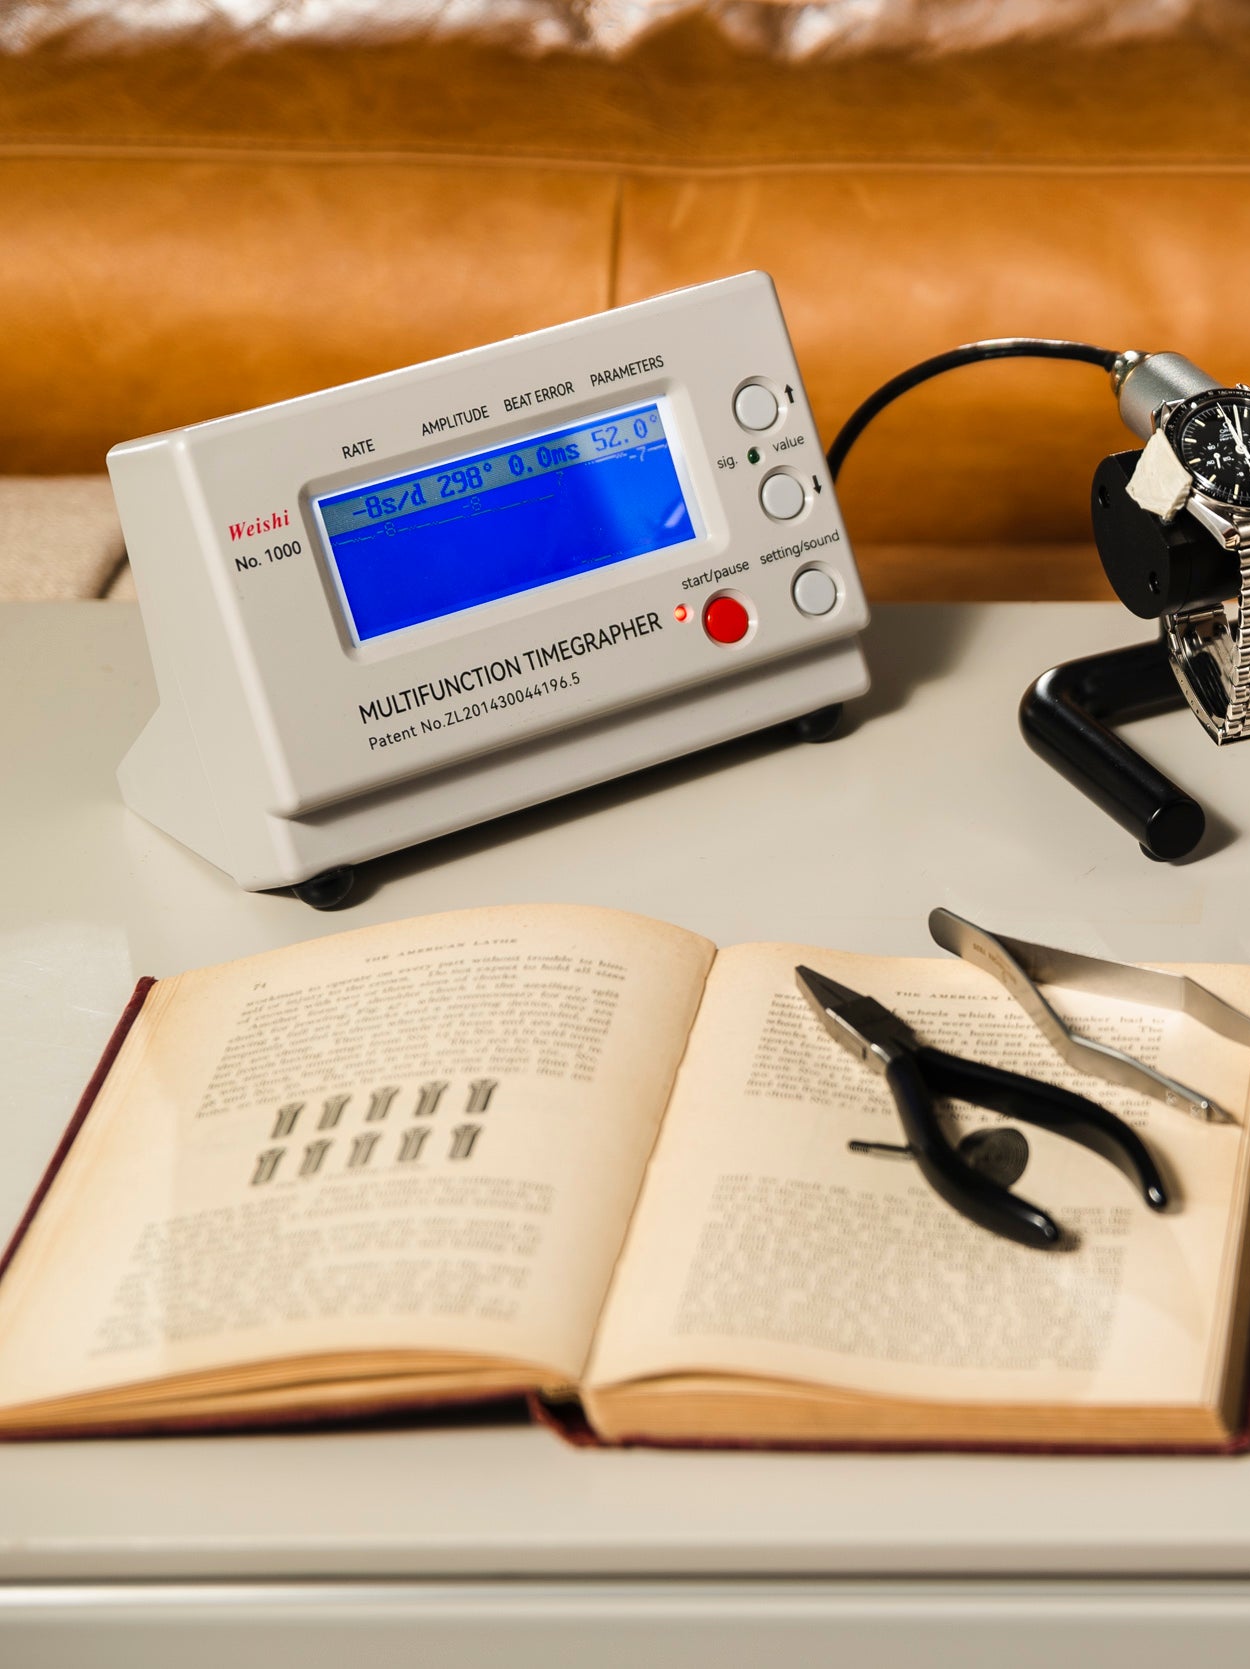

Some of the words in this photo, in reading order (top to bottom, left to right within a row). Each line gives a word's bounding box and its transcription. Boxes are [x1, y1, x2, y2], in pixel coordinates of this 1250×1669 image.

[590, 355, 664, 387] PARAMETERS
[503, 392, 532, 412] BEAT
[534, 381, 575, 406] ERROR
[422, 405, 490, 436] AMPLITUDE
[342, 438, 376, 459] RATE
[772, 434, 805, 453] value
[352, 482, 426, 519] -8s/d
[437, 462, 493, 498] 298°
[508, 442, 581, 477] 0.0ms
[592, 414, 658, 451] 52.0°
[717, 457, 738, 474] sig.
[228, 510, 291, 542] Weishi
[235, 554, 262, 572] No.
[264, 540, 302, 563] 1000
[760, 530, 840, 565] setting/sound
[681, 560, 750, 590] start/pause
[358, 656, 522, 724] MULTIFUNCTION
[522, 612, 662, 671] TIMEGRAPHER
[368, 725, 418, 750] Patent
[420, 672, 581, 734] No.ZL201430044196.5
[365, 955, 389, 963] THE
[398, 942, 465, 956] AMERICAN
[473, 938, 518, 946] LATHE
[896, 990, 921, 998] THE
[928, 993, 999, 1001] AMERICAN
[906, 1008, 949, 1018] wheels
[958, 1011, 996, 1020] which
[1004, 1012, 1024, 1021] the
[978, 1022, 1036, 1030] considere
